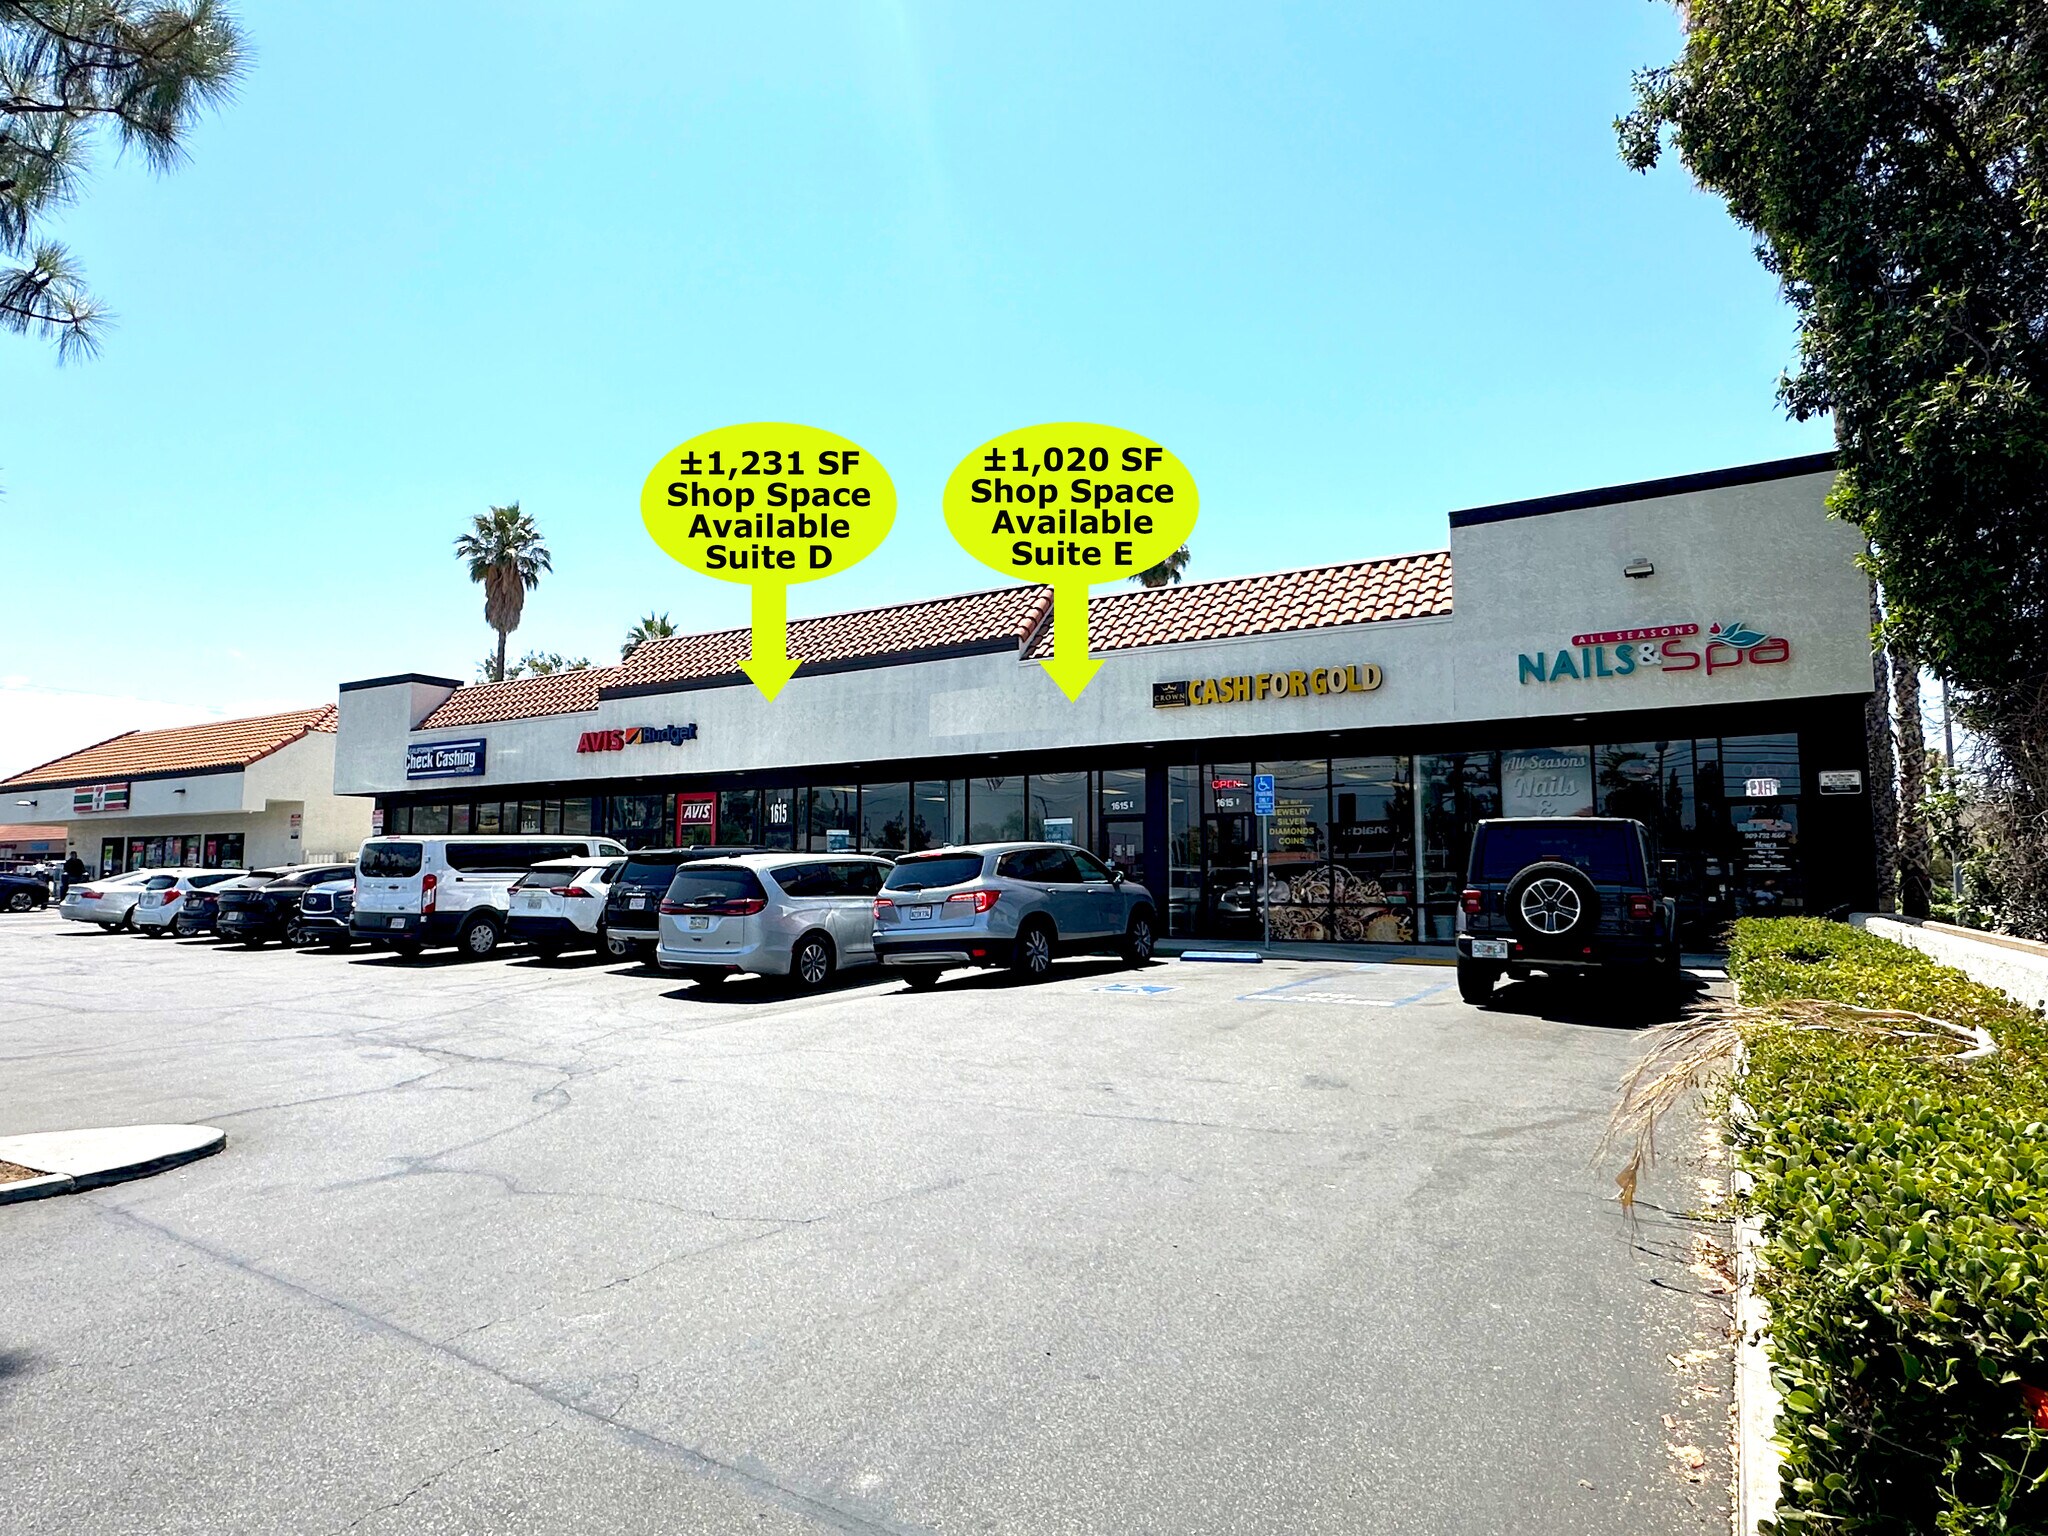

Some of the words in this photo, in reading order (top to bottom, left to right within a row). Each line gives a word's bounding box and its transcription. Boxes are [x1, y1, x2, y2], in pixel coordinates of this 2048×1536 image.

[1578, 634, 1605, 644] ALL
[1616, 625, 1695, 641] SEASONS
[1518, 644, 1635, 685] NAILS
[1662, 638, 1789, 676] Spa
[1188, 675, 1252, 705] CASH
[1255, 669, 1308, 700] FOR
[1310, 662, 1383, 695] GOLD
[1154, 693, 1185, 702] CROWN
[577, 730, 625, 753] AVIS
[641, 723, 698, 746] Budget
[404, 753, 433, 770] Check
[436, 749, 476, 768] Cashing
[1503, 756, 1526, 772] All
[1529, 755, 1587, 770] Seasons
[1211, 780, 1241, 790] OPEN
[1514, 776, 1580, 799] Nails
[1111, 801, 1129, 811] 1615
[1215, 798, 1234, 807] 1615
[683, 804, 711, 819] AVIS
[770, 803, 788, 824] 1615
[1277, 818, 1306, 826] SILVER
[1269, 827, 1315, 836] DIAMONDS
